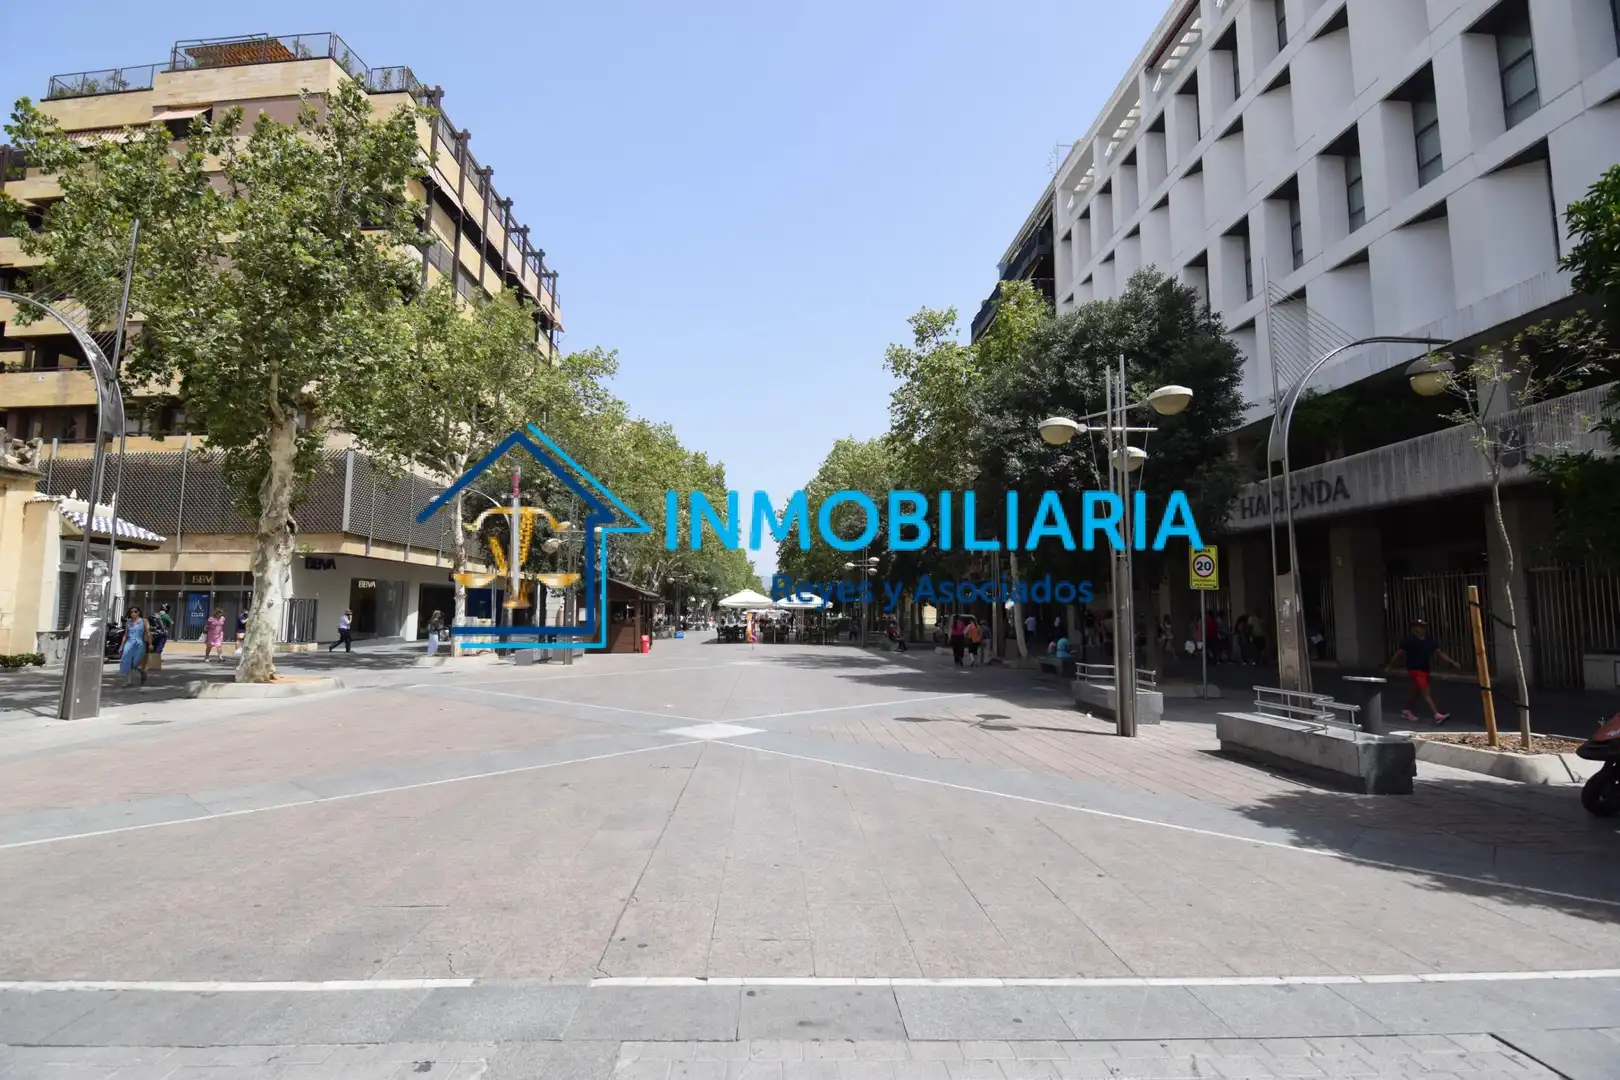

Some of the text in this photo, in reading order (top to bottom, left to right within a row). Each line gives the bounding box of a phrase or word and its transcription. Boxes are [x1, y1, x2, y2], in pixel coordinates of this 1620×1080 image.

[1241, 475, 1350, 519] HACIENDA
[305, 557, 337, 570] BBVA
[1196, 561, 1211, 571] 20
[358, 580, 376, 588] BBVA
